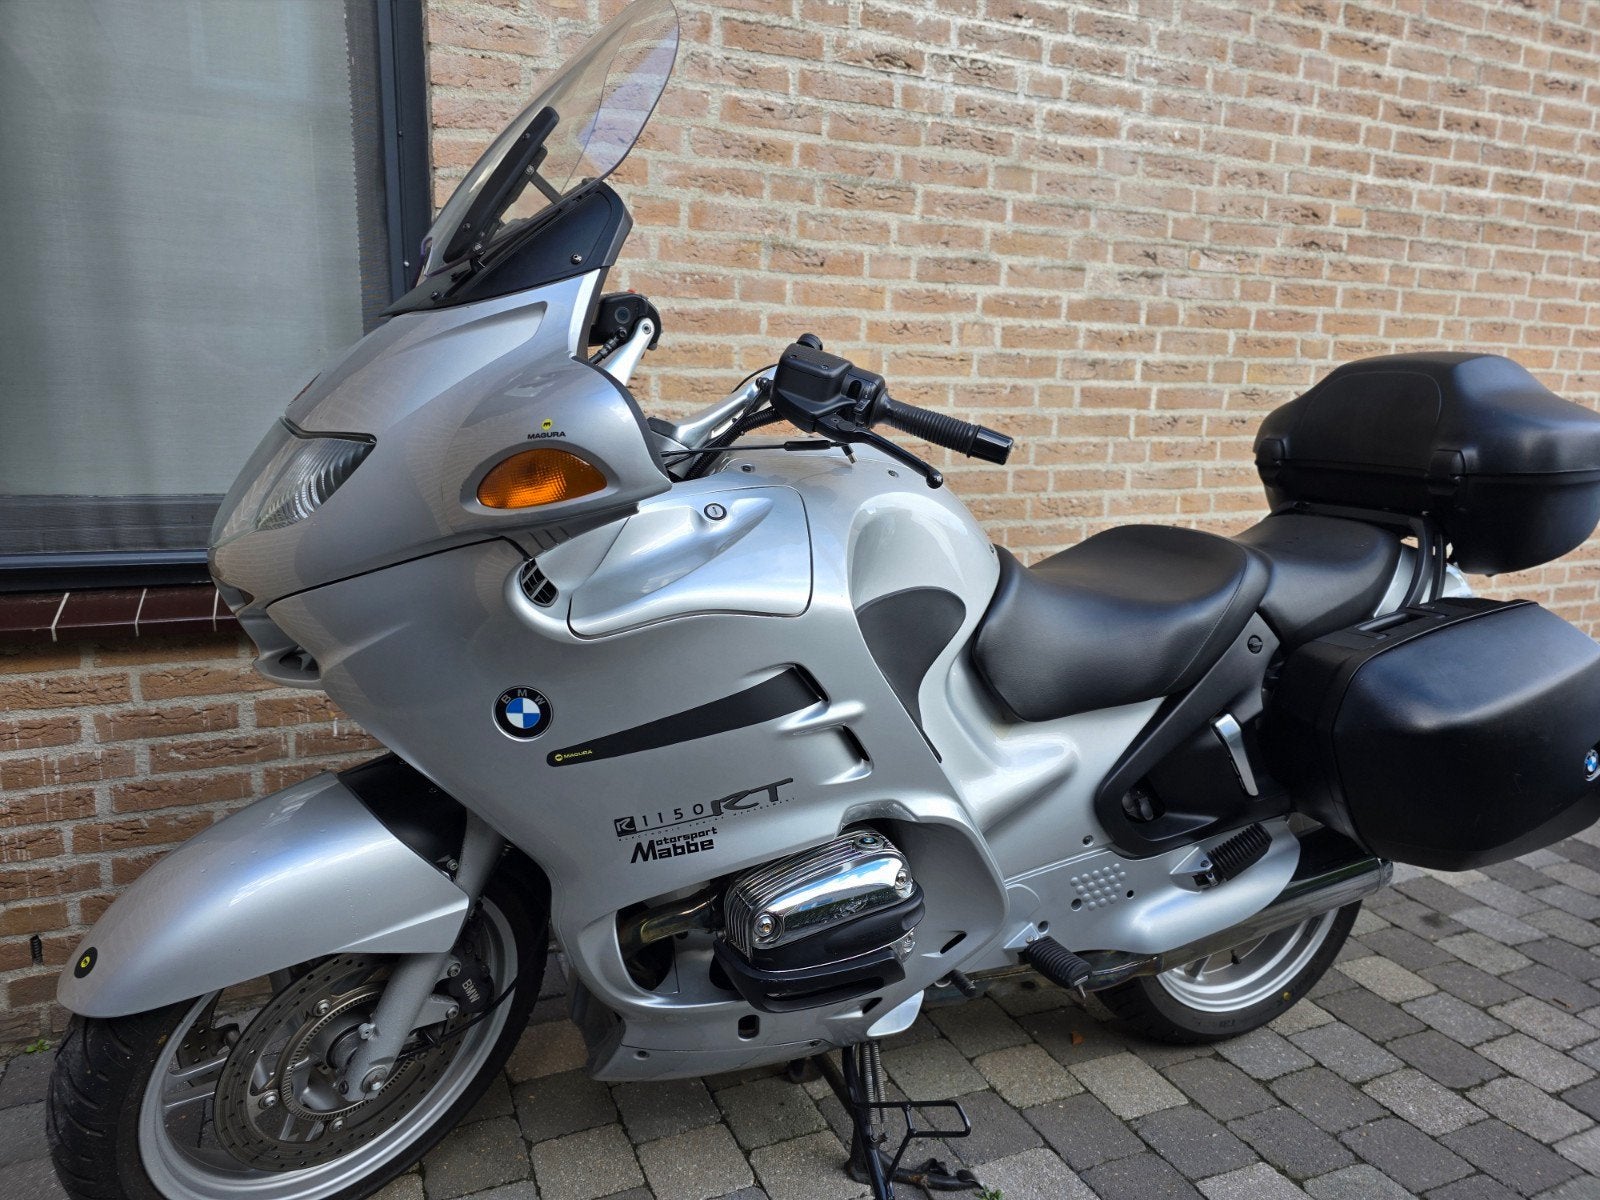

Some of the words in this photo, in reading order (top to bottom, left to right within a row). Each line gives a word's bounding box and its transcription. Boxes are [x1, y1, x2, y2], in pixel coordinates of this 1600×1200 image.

[527, 431, 566, 439] MAGURA
[500, 688, 546, 706] BMW
[641, 803, 704, 827] 1150
[711, 777, 794, 816] RT
[630, 838, 715, 864] Mabbe
[462, 978, 480, 1003] BMW
